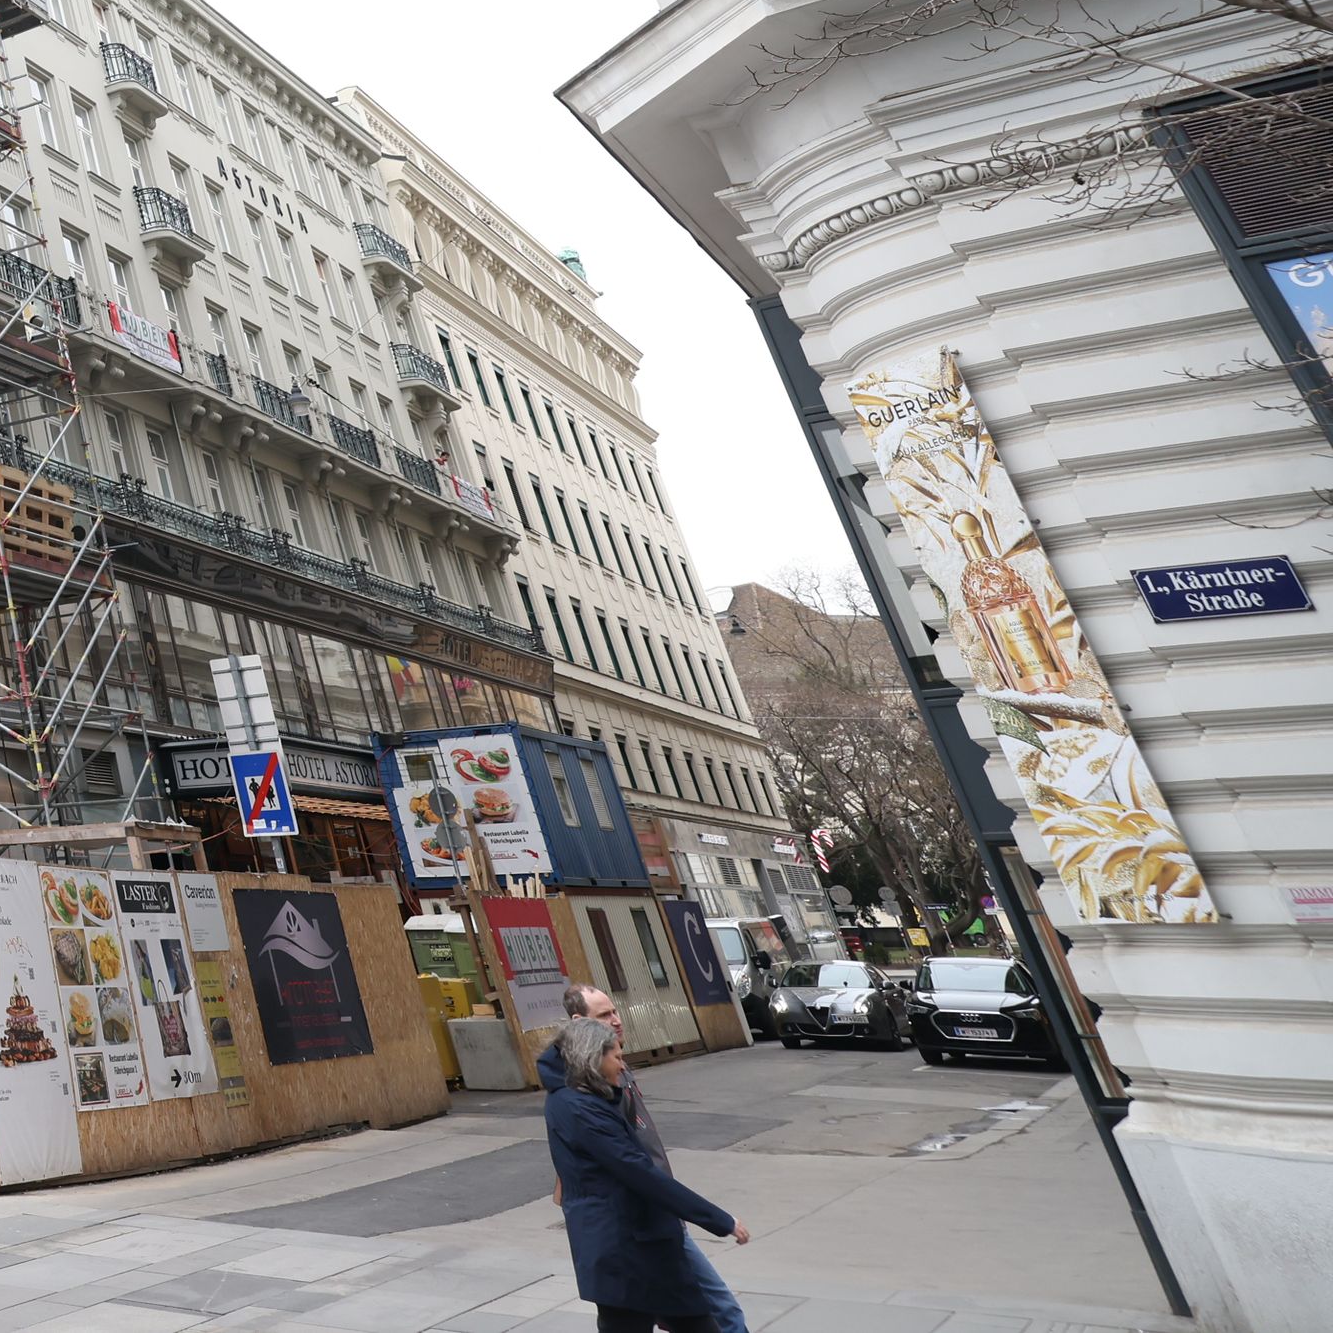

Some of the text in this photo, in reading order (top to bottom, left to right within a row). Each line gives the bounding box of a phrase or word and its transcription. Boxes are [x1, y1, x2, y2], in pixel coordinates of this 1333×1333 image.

[217, 156, 308, 234] ASTORIA
[868, 384, 959, 428] GUERLAIN
[891, 431, 968, 460] AQUA ALLEGORIA
[1143, 566, 1285, 595] 1., Kärntner-
[1185, 588, 1265, 612] Straße
[288, 753, 332, 781] HOTEL
[122, 884, 156, 901] LASTER
[185, 885, 216, 899] Caverion
[503, 934, 557, 964] HUBER
